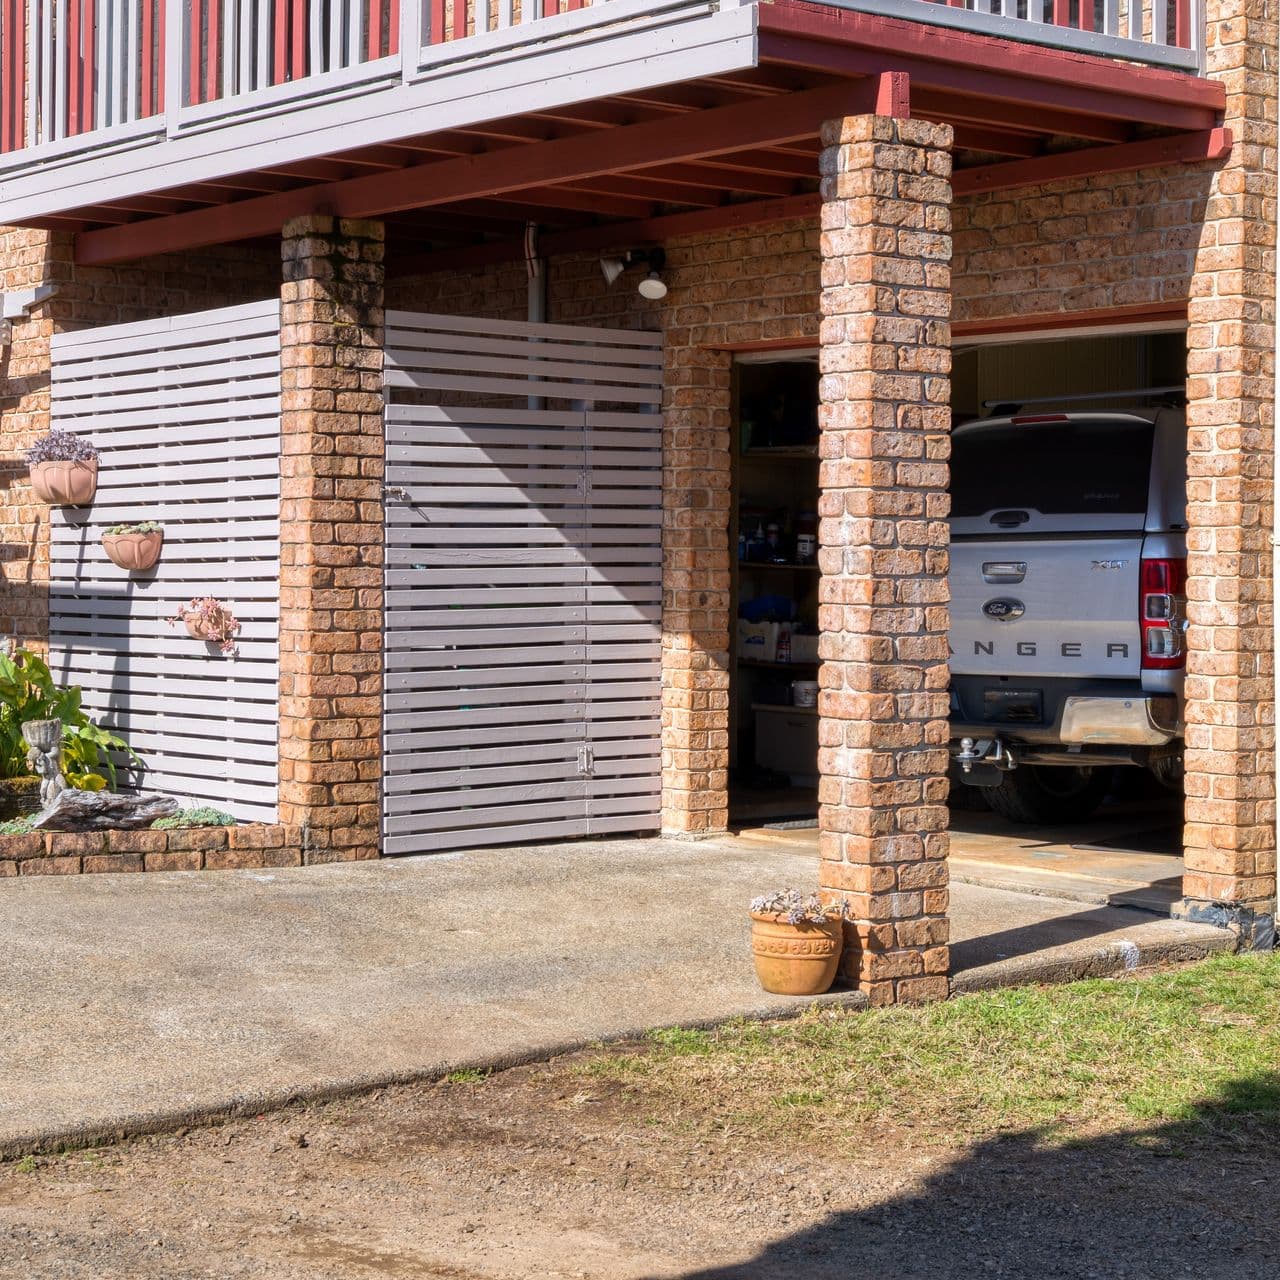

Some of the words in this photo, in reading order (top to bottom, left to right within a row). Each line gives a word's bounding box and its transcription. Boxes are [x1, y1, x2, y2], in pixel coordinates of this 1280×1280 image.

[1091, 560, 1129, 570] XLT
[988, 603, 1008, 614] Ford
[949, 641, 1129, 658] NGER
